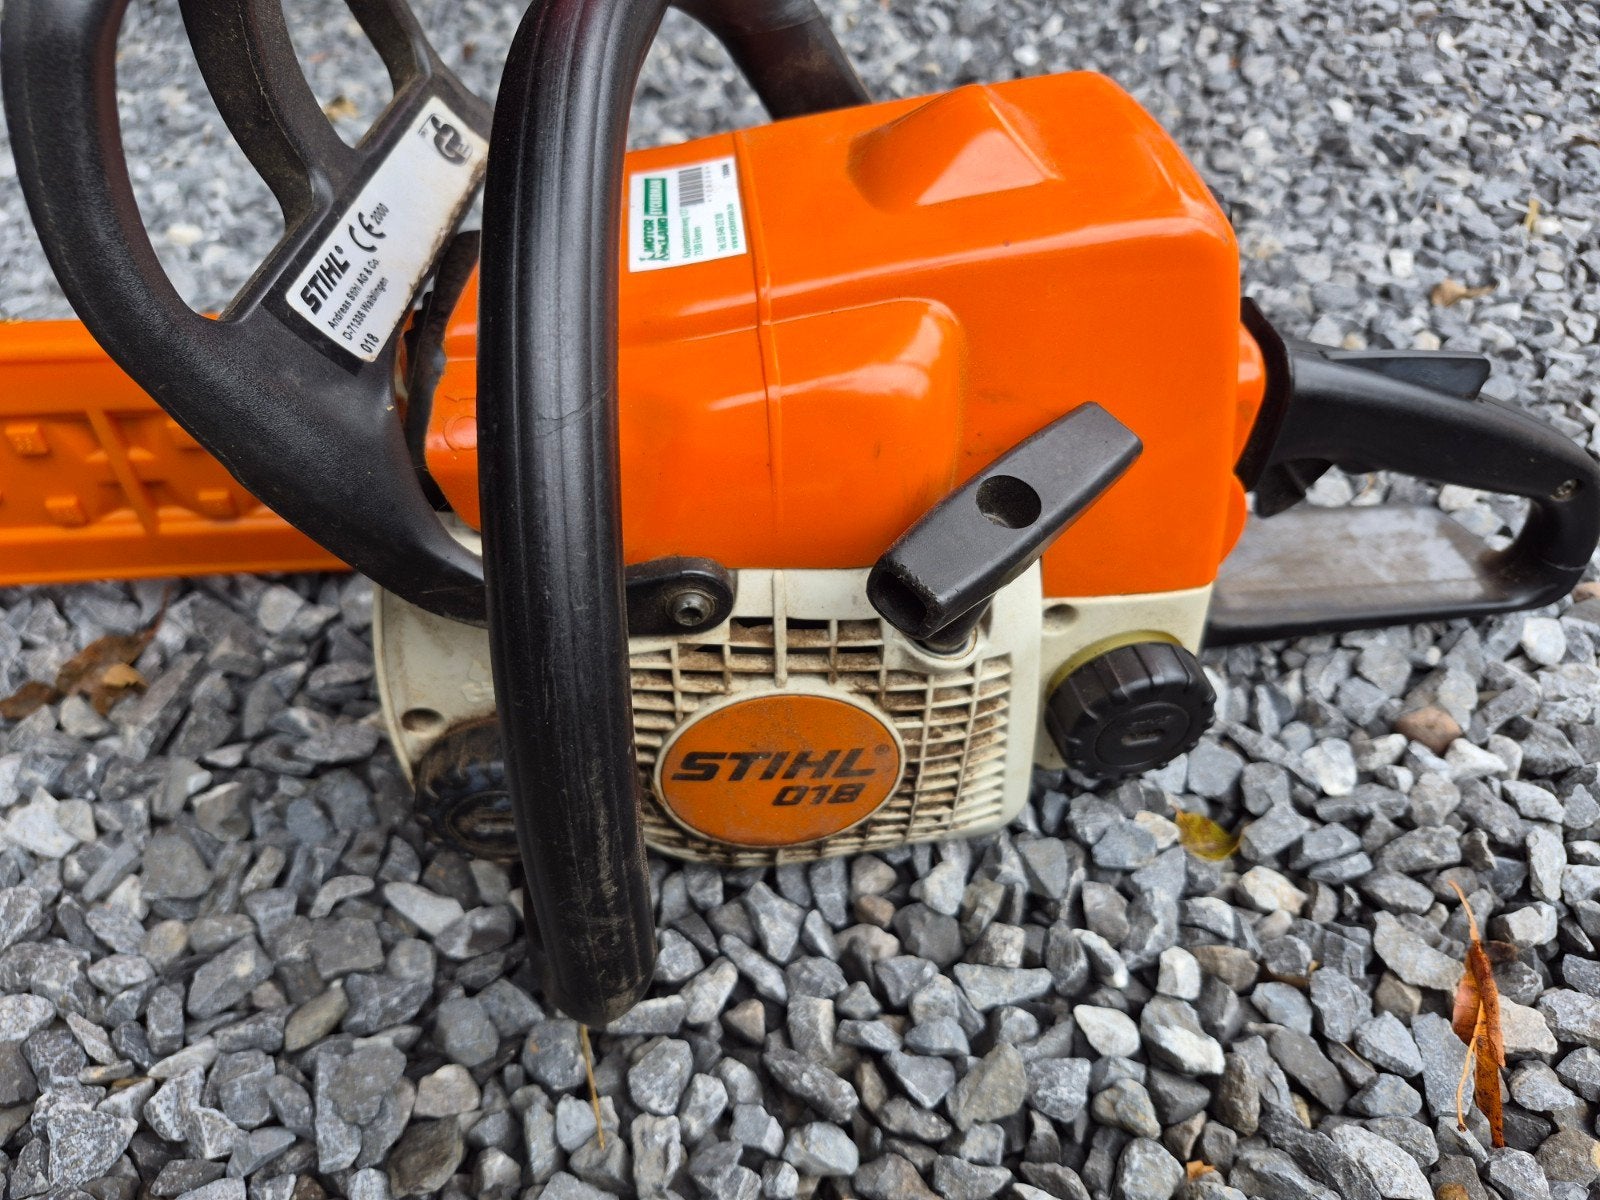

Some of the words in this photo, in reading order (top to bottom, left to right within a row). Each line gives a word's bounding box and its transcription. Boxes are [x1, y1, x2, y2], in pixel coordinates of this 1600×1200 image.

[369, 202, 390, 226] 2000
[644, 219, 655, 252] MOTOR
[327, 299, 352, 330] Andreas
[345, 283, 362, 302] Stihl
[356, 272, 369, 287] AG
[363, 267, 373, 276] &
[342, 310, 367, 341] D-71336
[359, 277, 388, 313] Waiblingen
[360, 332, 380, 354] 018
[772, 783, 866, 806] 018
